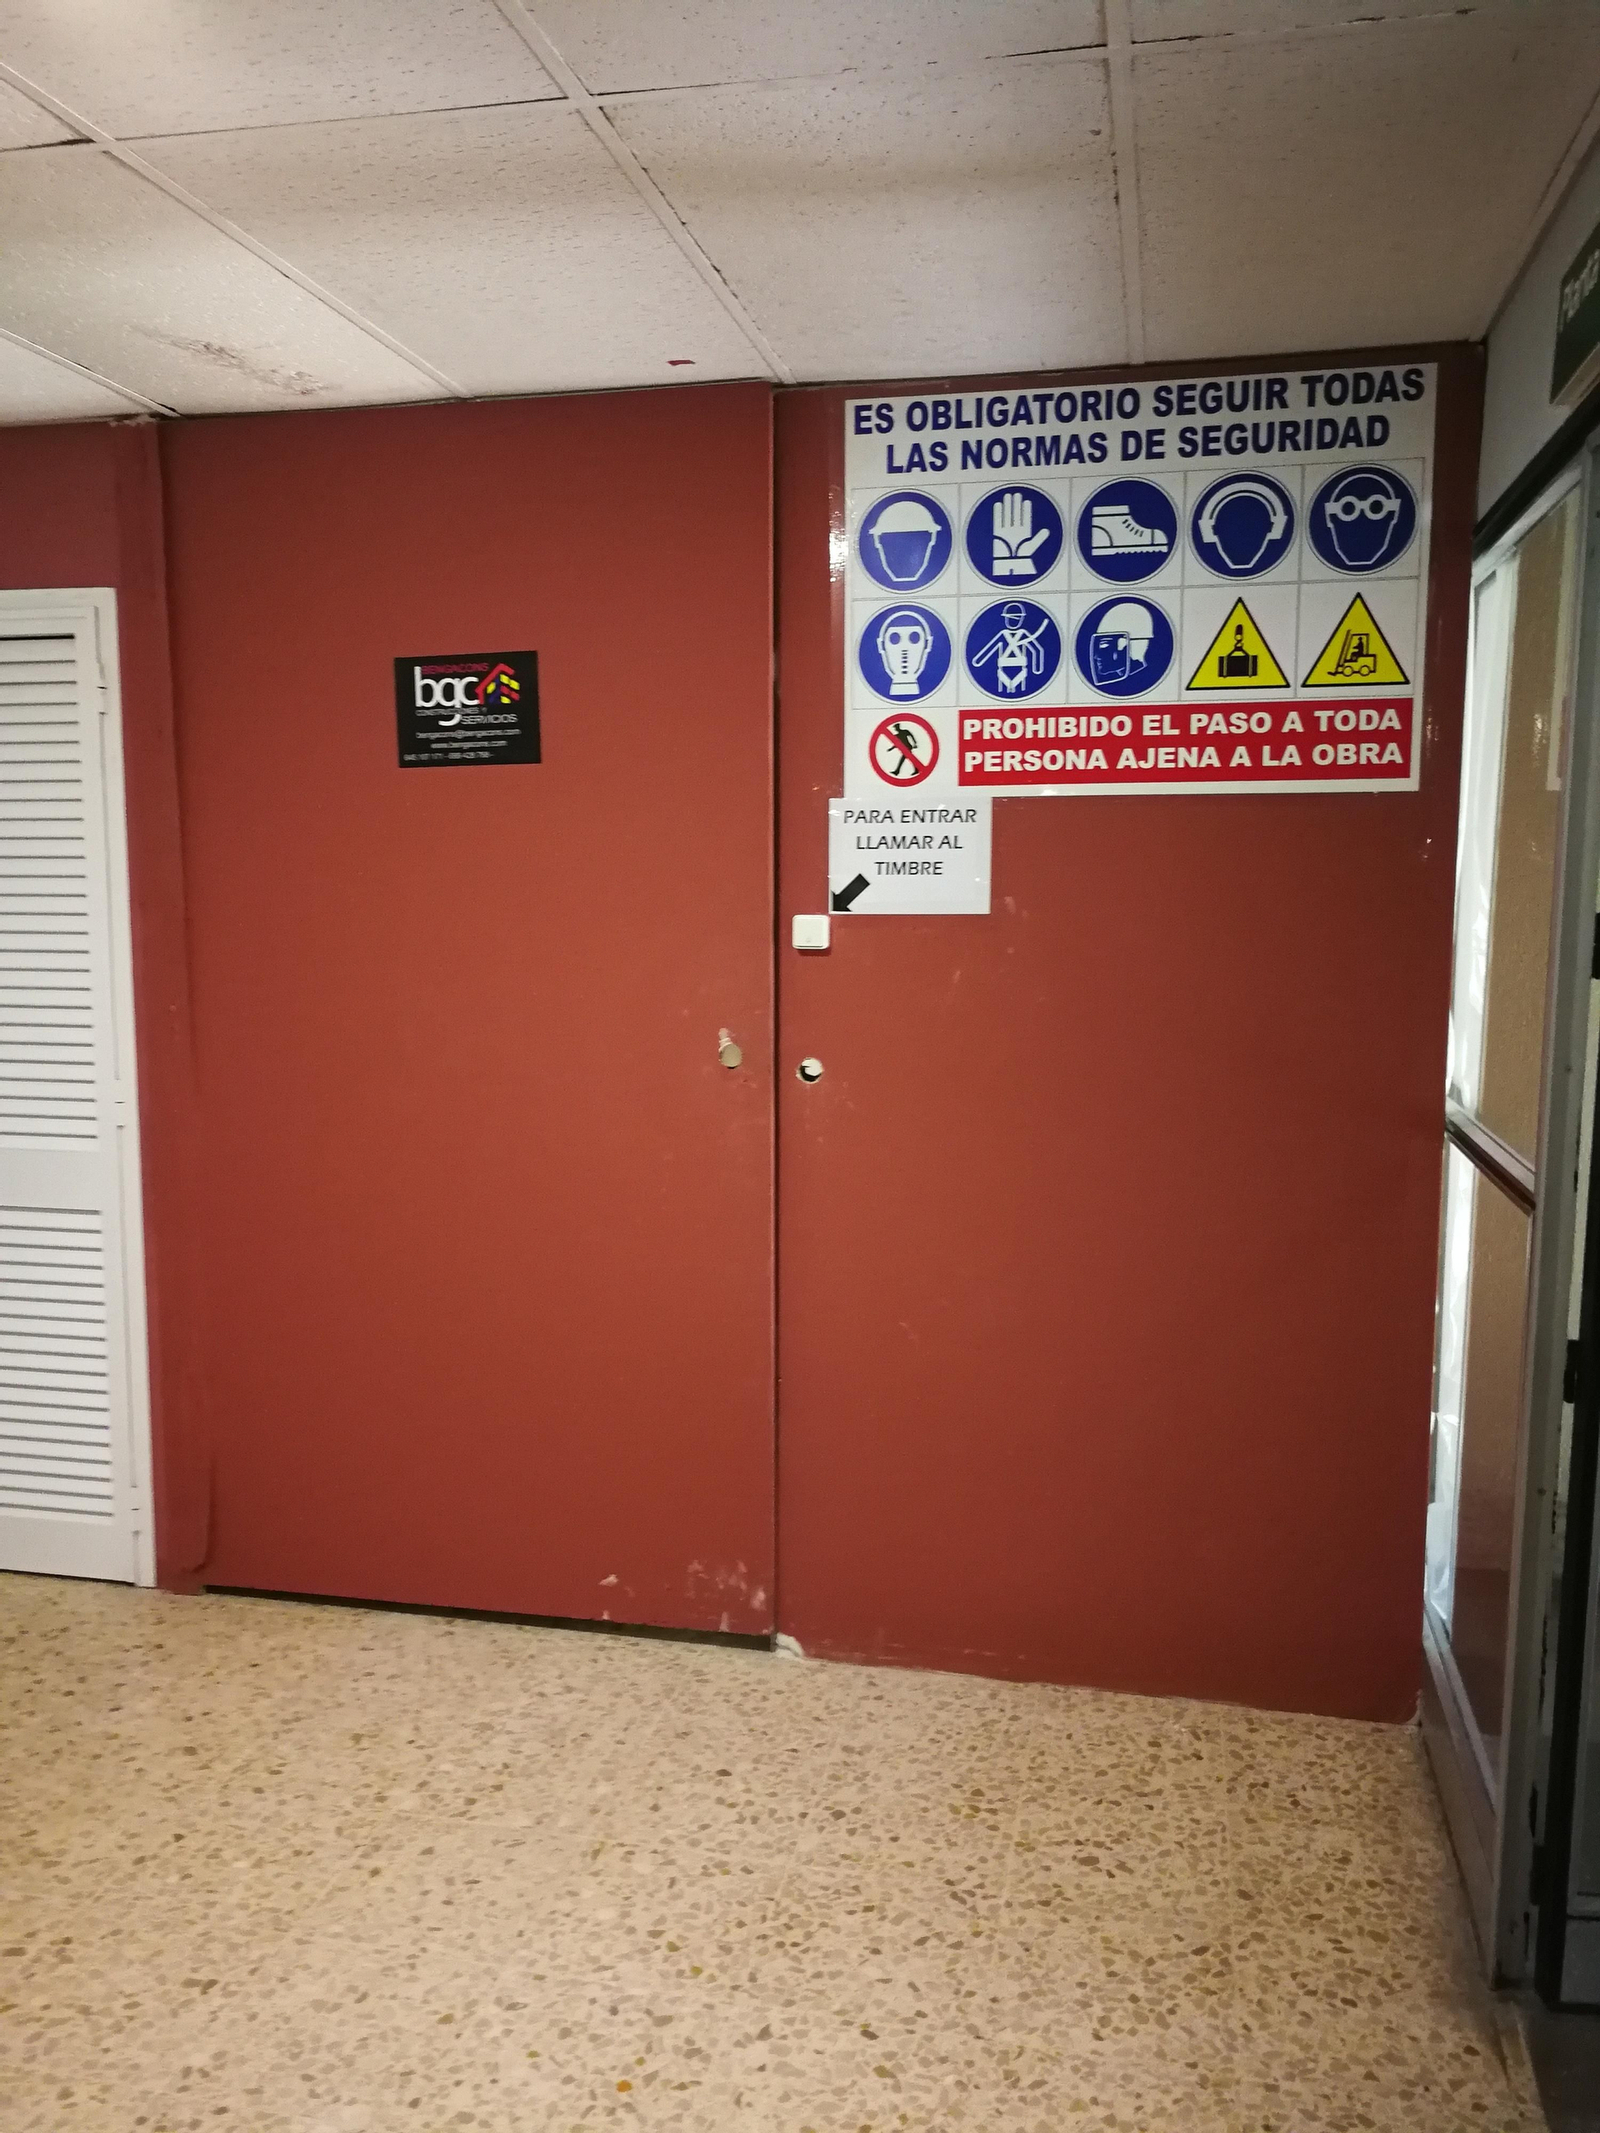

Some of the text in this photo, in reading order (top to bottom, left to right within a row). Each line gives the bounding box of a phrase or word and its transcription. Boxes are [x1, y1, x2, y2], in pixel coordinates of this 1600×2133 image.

[853, 369, 1425, 435] ES OBLIGATORIO SEGUIR TODAS
[886, 415, 1390, 474] LAS NORMAS DE SEGURIDAD
[414, 666, 479, 726] bgc
[462, 714, 519, 725] SERVICIOS
[963, 709, 1402, 741] PROHIBIDO EL PASO A TODA
[964, 743, 1404, 773] PERSONA AJENA A LA OBRA
[843, 808, 977, 824] PARA ENTRAR
[856, 835, 964, 850] LLAMAR AL
[874, 861, 944, 875] TIMBRE
